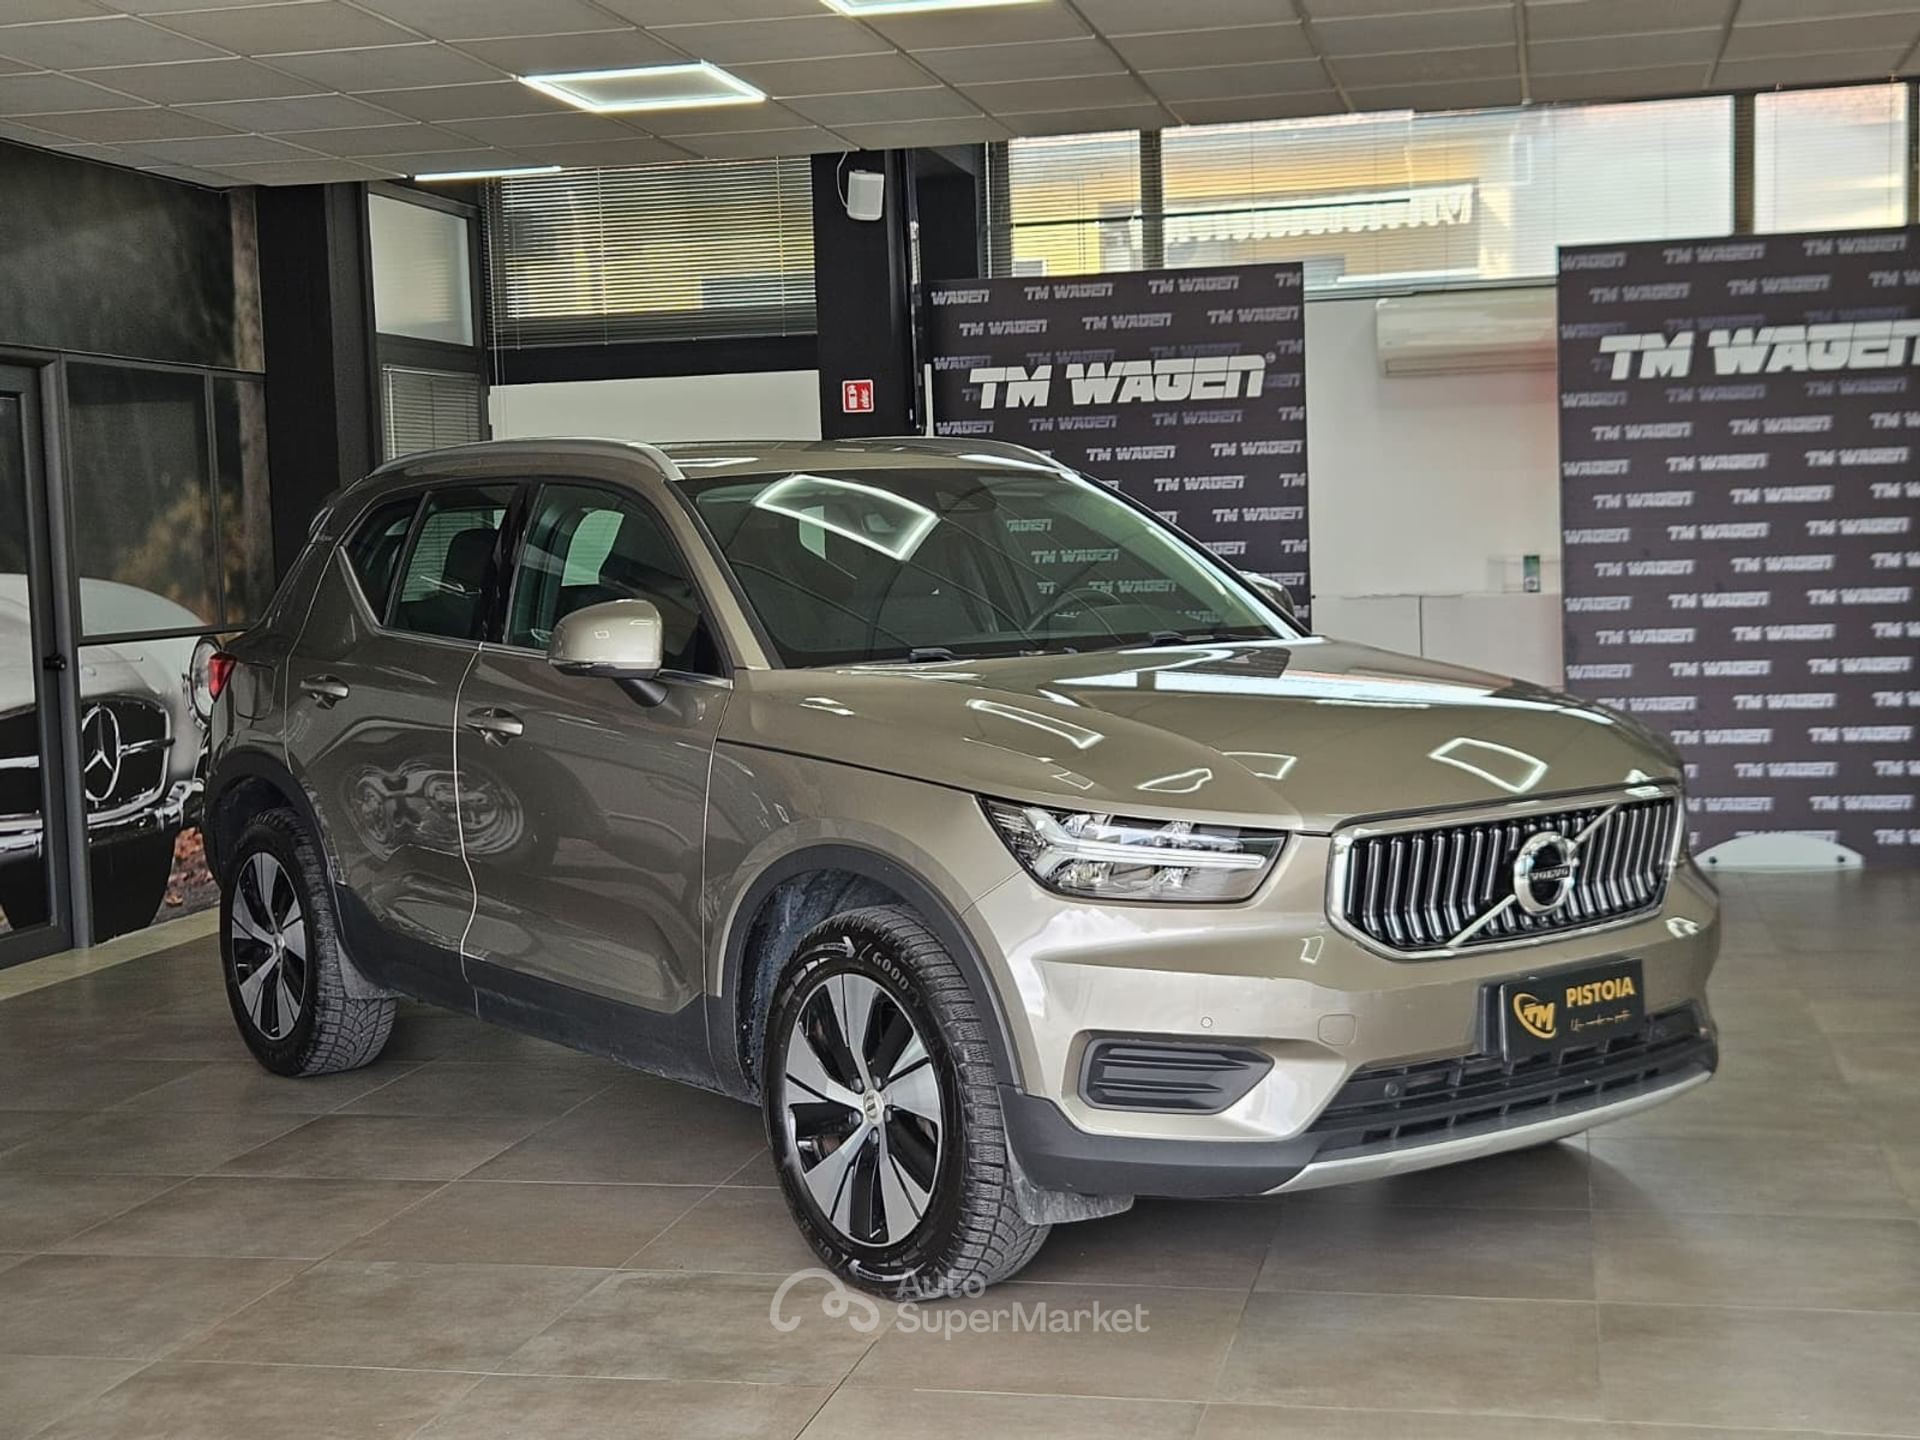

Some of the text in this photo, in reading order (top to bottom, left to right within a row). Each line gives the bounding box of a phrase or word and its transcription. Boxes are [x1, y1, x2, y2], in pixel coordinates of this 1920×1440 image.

[1803, 235, 1907, 256] TM WAGEN
[1663, 244, 1765, 264] TM WAGEN
[1148, 276, 1239, 294] TM WAGEN
[1727, 275, 1830, 295] TM WAGEN
[1869, 271, 1899, 286] TM
[931, 289, 990, 305] WAGEN
[1024, 283, 1113, 300] TM WAGEN
[1589, 283, 1690, 303] TM WAGEN
[1082, 313, 1172, 330] TM WAGEN
[1207, 306, 1299, 323] TM WAGEN
[959, 319, 1047, 336] TM WAGEN
[1600, 331, 1695, 381] TM
[969, 354, 1266, 409] TM WAGEN
[1805, 378, 1907, 396] TM WAGEN
[1666, 385, 1765, 403] TM WAGEN
[1029, 415, 1116, 431] TM WAGEN
[1152, 410, 1243, 426] TM WAGEN
[1729, 416, 1831, 434] TM WAGEN
[1870, 413, 1900, 428] TM
[936, 421, 994, 435] WAGEN
[1592, 422, 1692, 440] TM WAGEN
[1086, 445, 1176, 461] TM WAGEN
[1211, 440, 1302, 456] TM WAGEN
[1666, 453, 1768, 471] TM WAGEN
[1805, 447, 1908, 466] TM WAGEN
[1154, 475, 1245, 491] TM WAGEN
[1870, 483, 1901, 498] TM
[1593, 491, 1693, 508] TM WAGEN
[1730, 485, 1833, 503] TM WAGEN
[1212, 507, 1303, 522] TM WAGEN
[1667, 523, 1769, 540] TM WAGEN
[1806, 517, 1909, 535] TM WAGEN
[1031, 547, 1119, 564] TM WAGEN
[1731, 555, 1834, 572] TM WAGEN
[1871, 553, 1902, 568] TM
[1594, 560, 1694, 576] TM WAGEN
[1668, 591, 1769, 608] TM WAGEN
[1807, 587, 1910, 604] TM WAGEN
[1596, 628, 1695, 644] TM WAGEN
[1732, 624, 1835, 641] TM WAGEN
[1872, 622, 1903, 637] TM
[1669, 660, 1770, 676] TM WAGEN
[1807, 657, 1911, 673] TM WAGEN
[1629, 696, 1697, 711] WAGEN
[1733, 693, 1835, 709] TM WAGEN
[1873, 692, 1903, 706] TM
[1671, 729, 1772, 744] TM WAGEN
[1808, 726, 1912, 742] TM WAGEN
[1734, 762, 1837, 777] TM WAGEN
[1874, 761, 1903, 775] TM
[1704, 796, 1774, 812] WAGEN
[1810, 795, 1913, 810] TM WAGEN
[1874, 830, 1904, 844] TM
[1566, 976, 1635, 1008] PISTOIA
